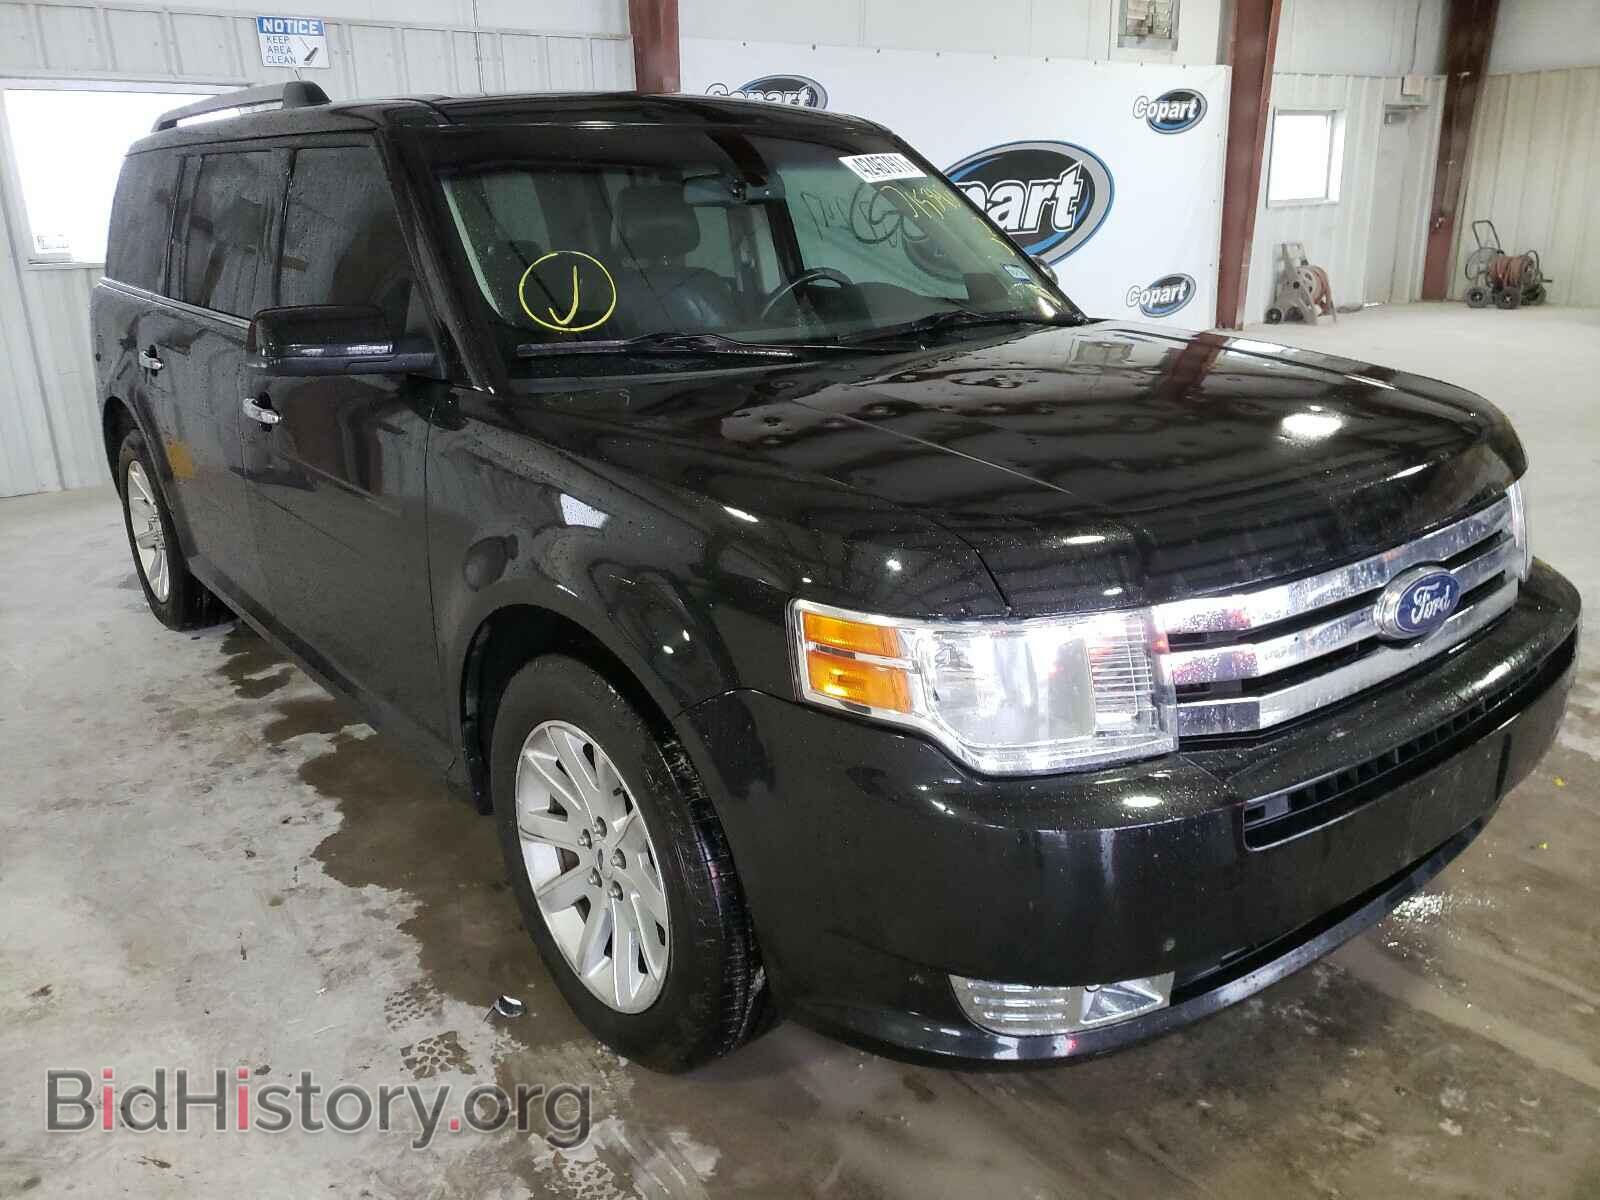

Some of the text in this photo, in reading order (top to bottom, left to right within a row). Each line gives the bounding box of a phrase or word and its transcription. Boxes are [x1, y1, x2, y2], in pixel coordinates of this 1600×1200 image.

[262, 18, 321, 34] NOTICE
[266, 35, 289, 44] KEEP
[267, 45, 292, 54] AREA
[266, 55, 297, 64] CLEAN
[1133, 95, 1198, 123] Copart
[1126, 280, 1187, 308] Copart
[1411, 581, 1452, 625] Ford
